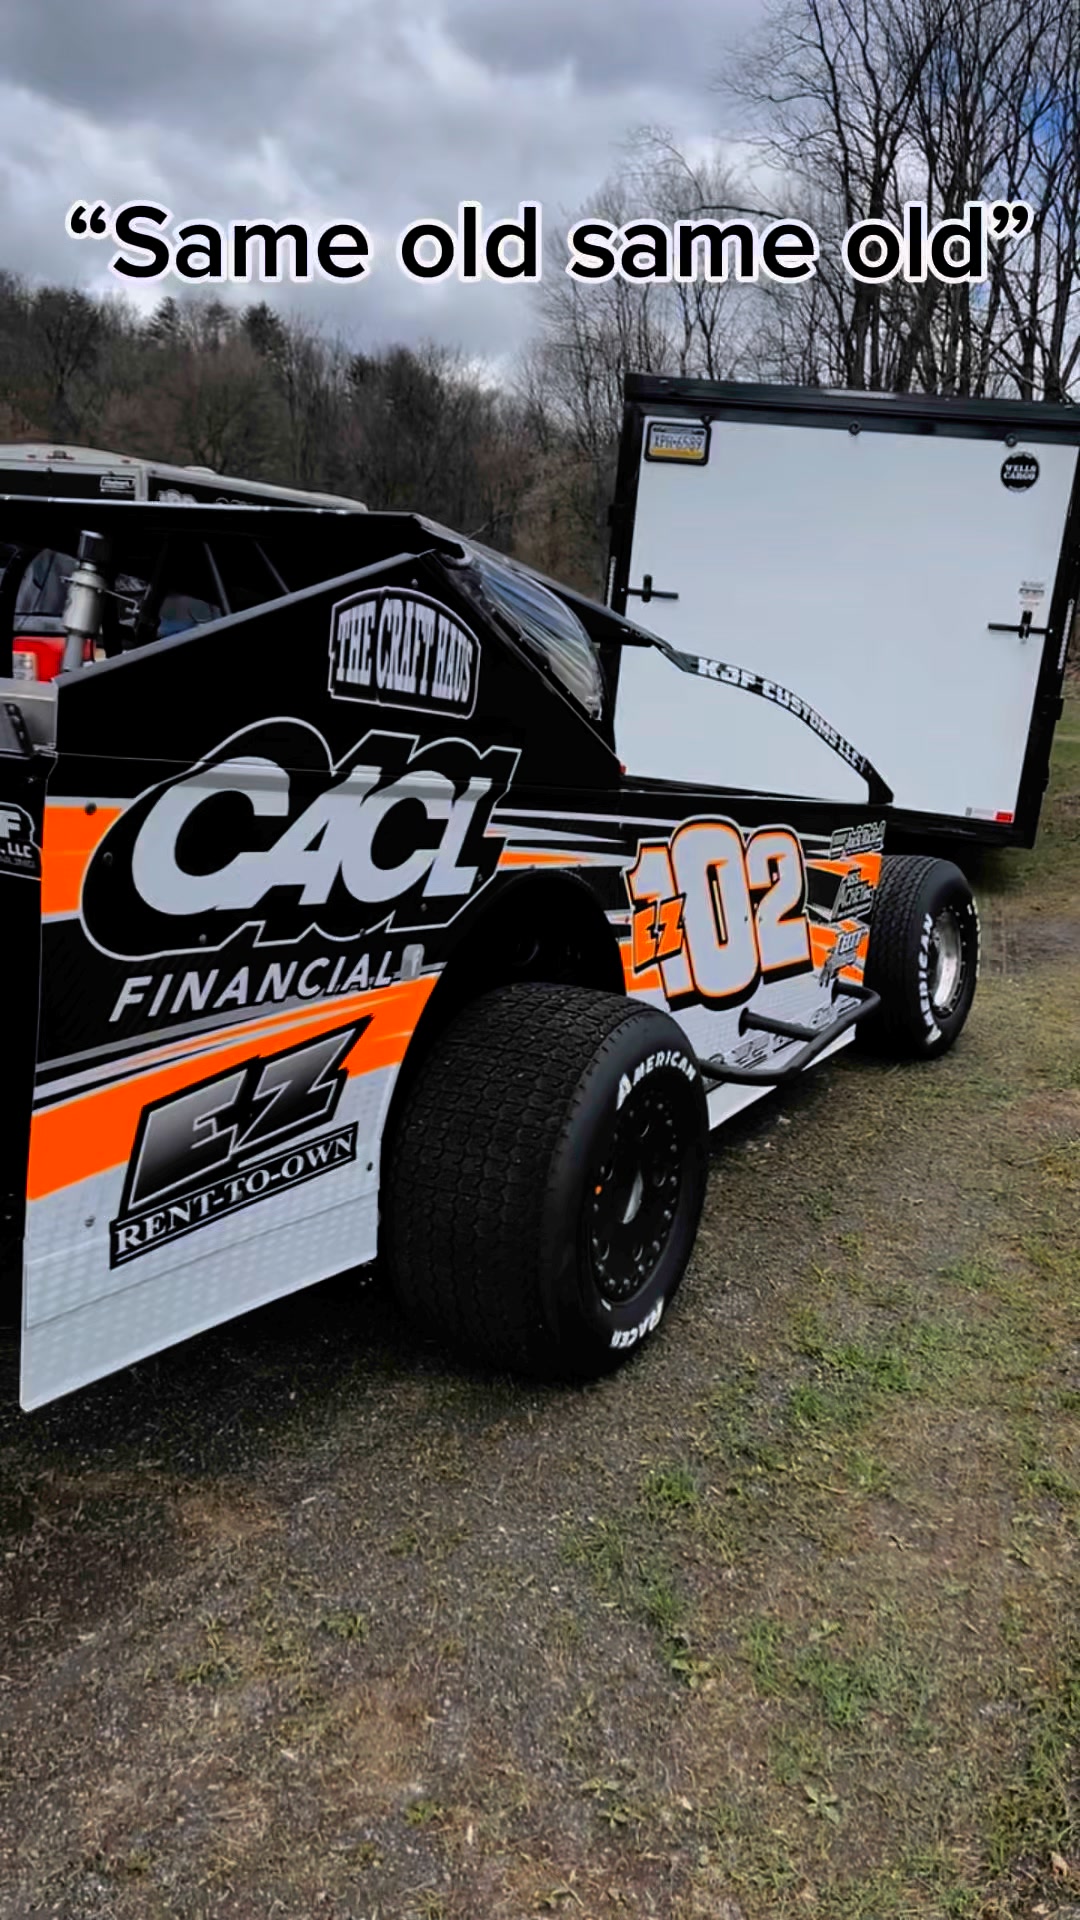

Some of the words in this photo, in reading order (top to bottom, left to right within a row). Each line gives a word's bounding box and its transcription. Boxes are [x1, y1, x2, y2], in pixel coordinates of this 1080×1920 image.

[336, 600, 376, 686] THE
[376, 598, 437, 696] CRAFT
[431, 613, 474, 703] HAUS
[761, 679, 839, 747] CUSTOMS
[131, 756, 493, 916] CACL
[626, 818, 812, 1004] 102
[633, 893, 687, 975] EZ
[109, 950, 393, 1023] FINANCIAL
[918, 912, 942, 1045] AMERICAN
[126, 1027, 358, 1212] EZ
[616, 1050, 697, 1111] AMERICAN
[114, 1131, 354, 1252] RENT-TO-OWN
[609, 1296, 664, 1348] RACER
